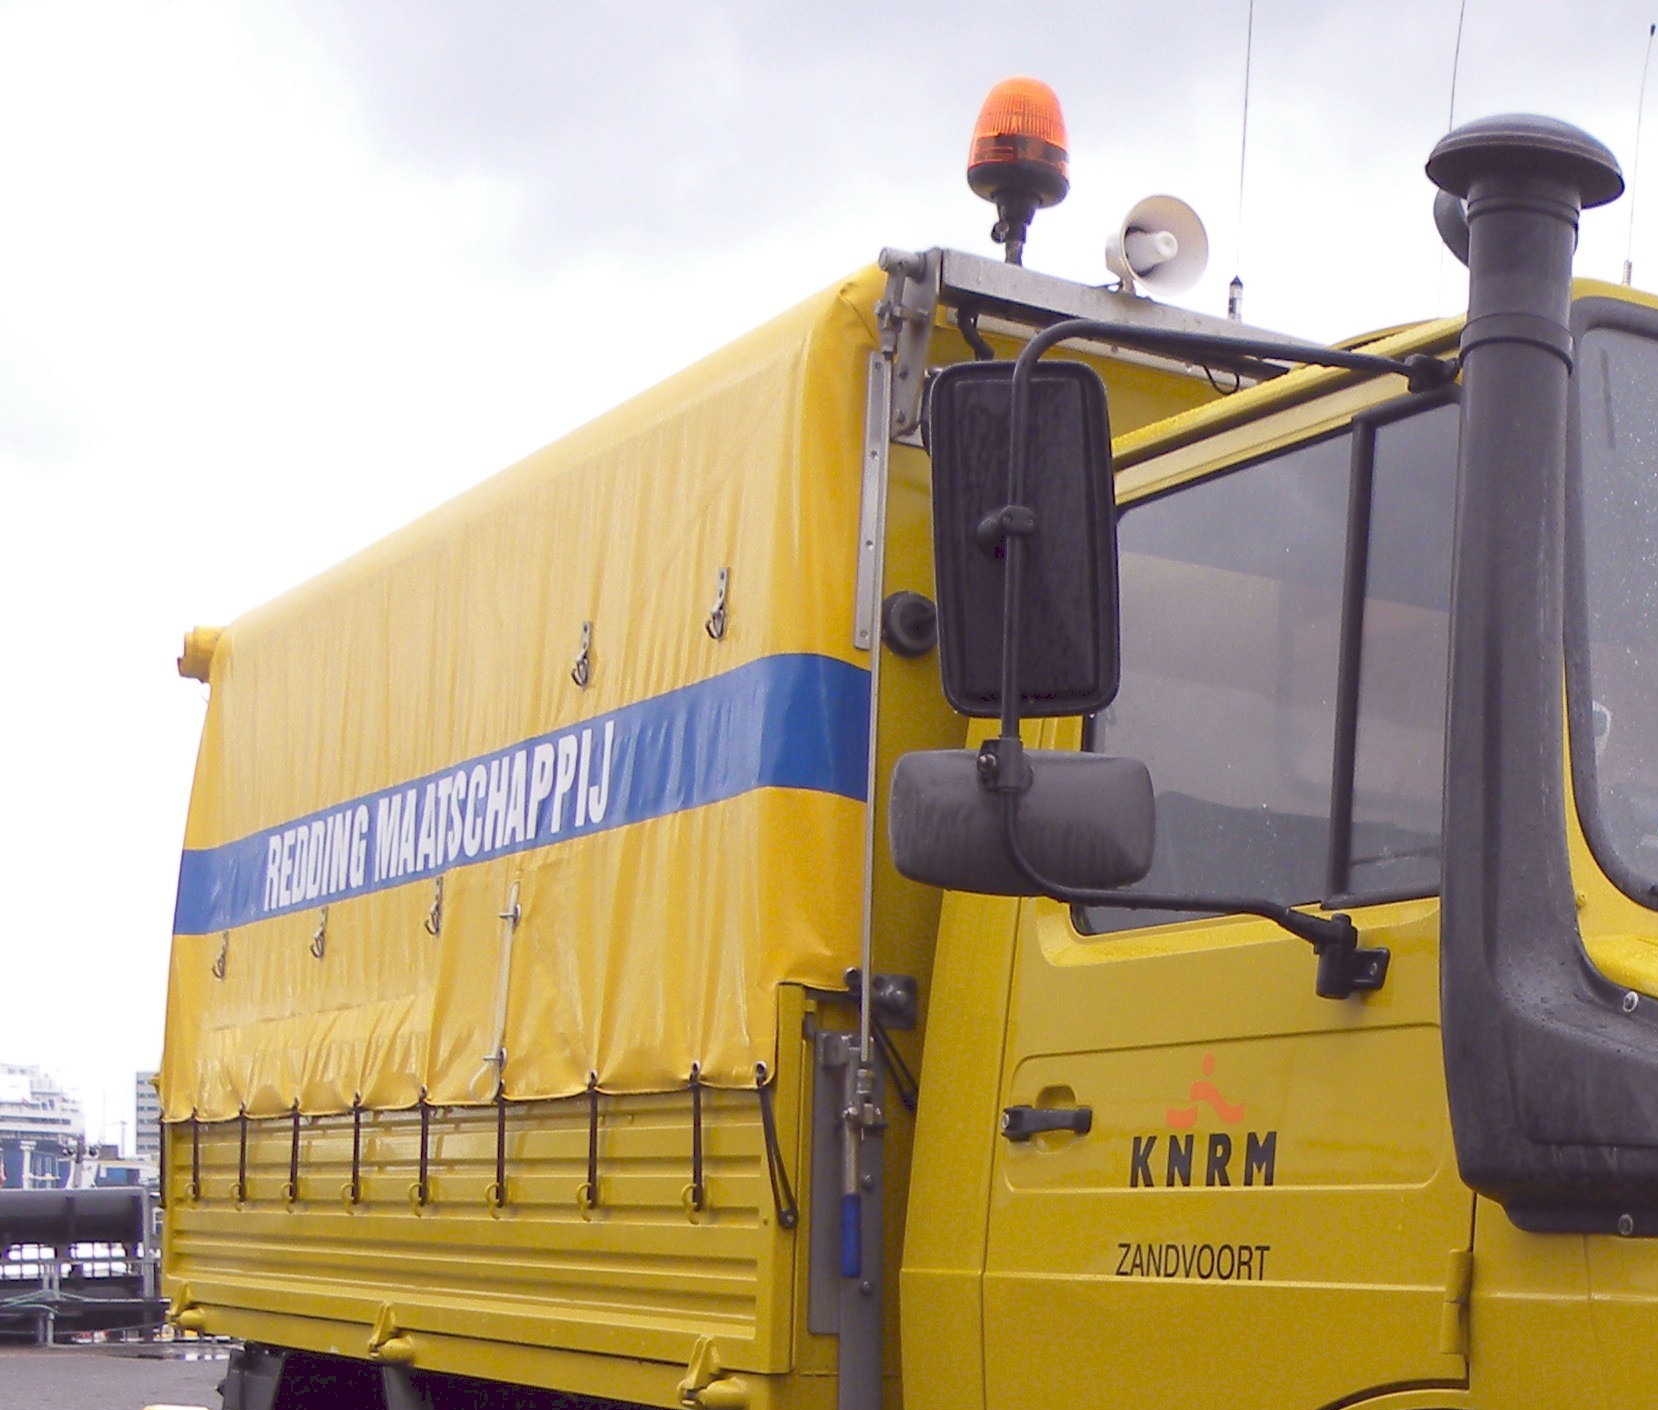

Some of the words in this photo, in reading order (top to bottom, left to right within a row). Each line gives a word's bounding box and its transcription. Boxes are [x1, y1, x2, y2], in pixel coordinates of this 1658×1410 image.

[264, 804, 369, 912] REDDING
[374, 720, 615, 881] MAATSCHAPPIJ
[1130, 1131, 1277, 1188] KNRM
[1116, 1243, 1271, 1282] ZANDVOORT
